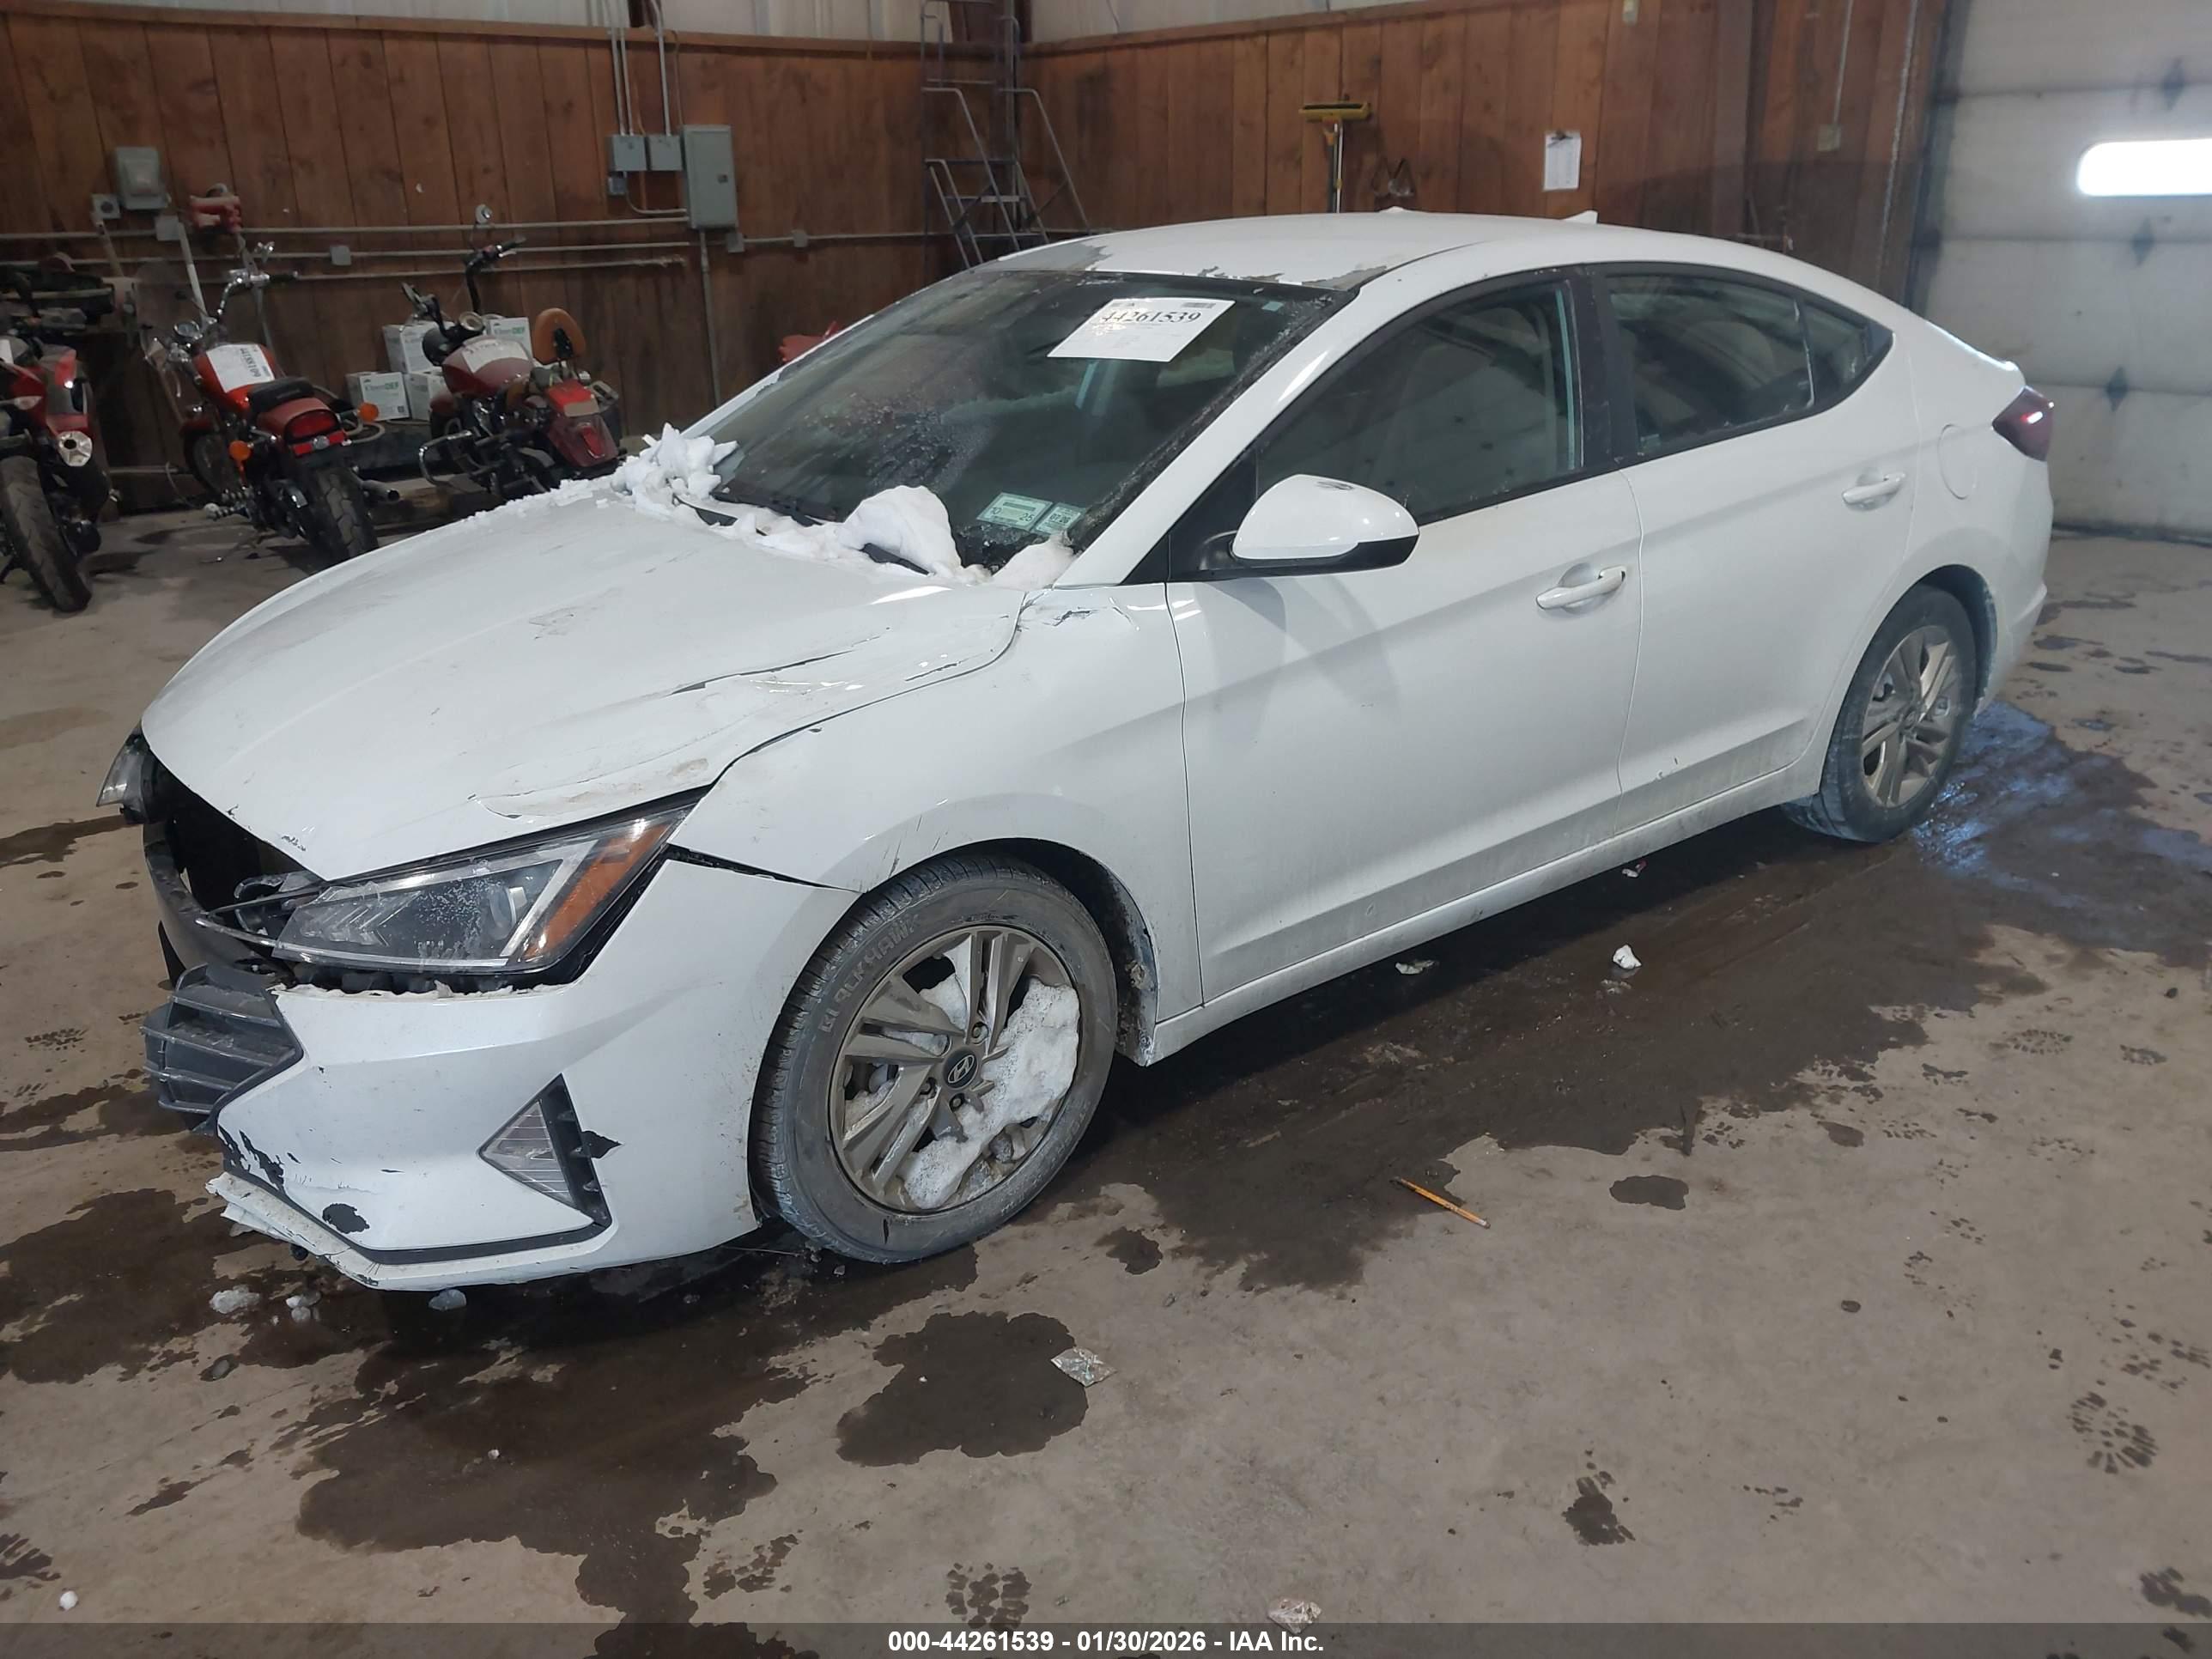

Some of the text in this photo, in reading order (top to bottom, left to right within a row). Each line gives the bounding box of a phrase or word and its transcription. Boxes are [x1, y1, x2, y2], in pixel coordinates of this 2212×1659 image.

[1102, 311, 1202, 324] 44261539
[1019, 513, 1035, 522] 25
[818, 913, 921, 1033] BLACKHAWK
